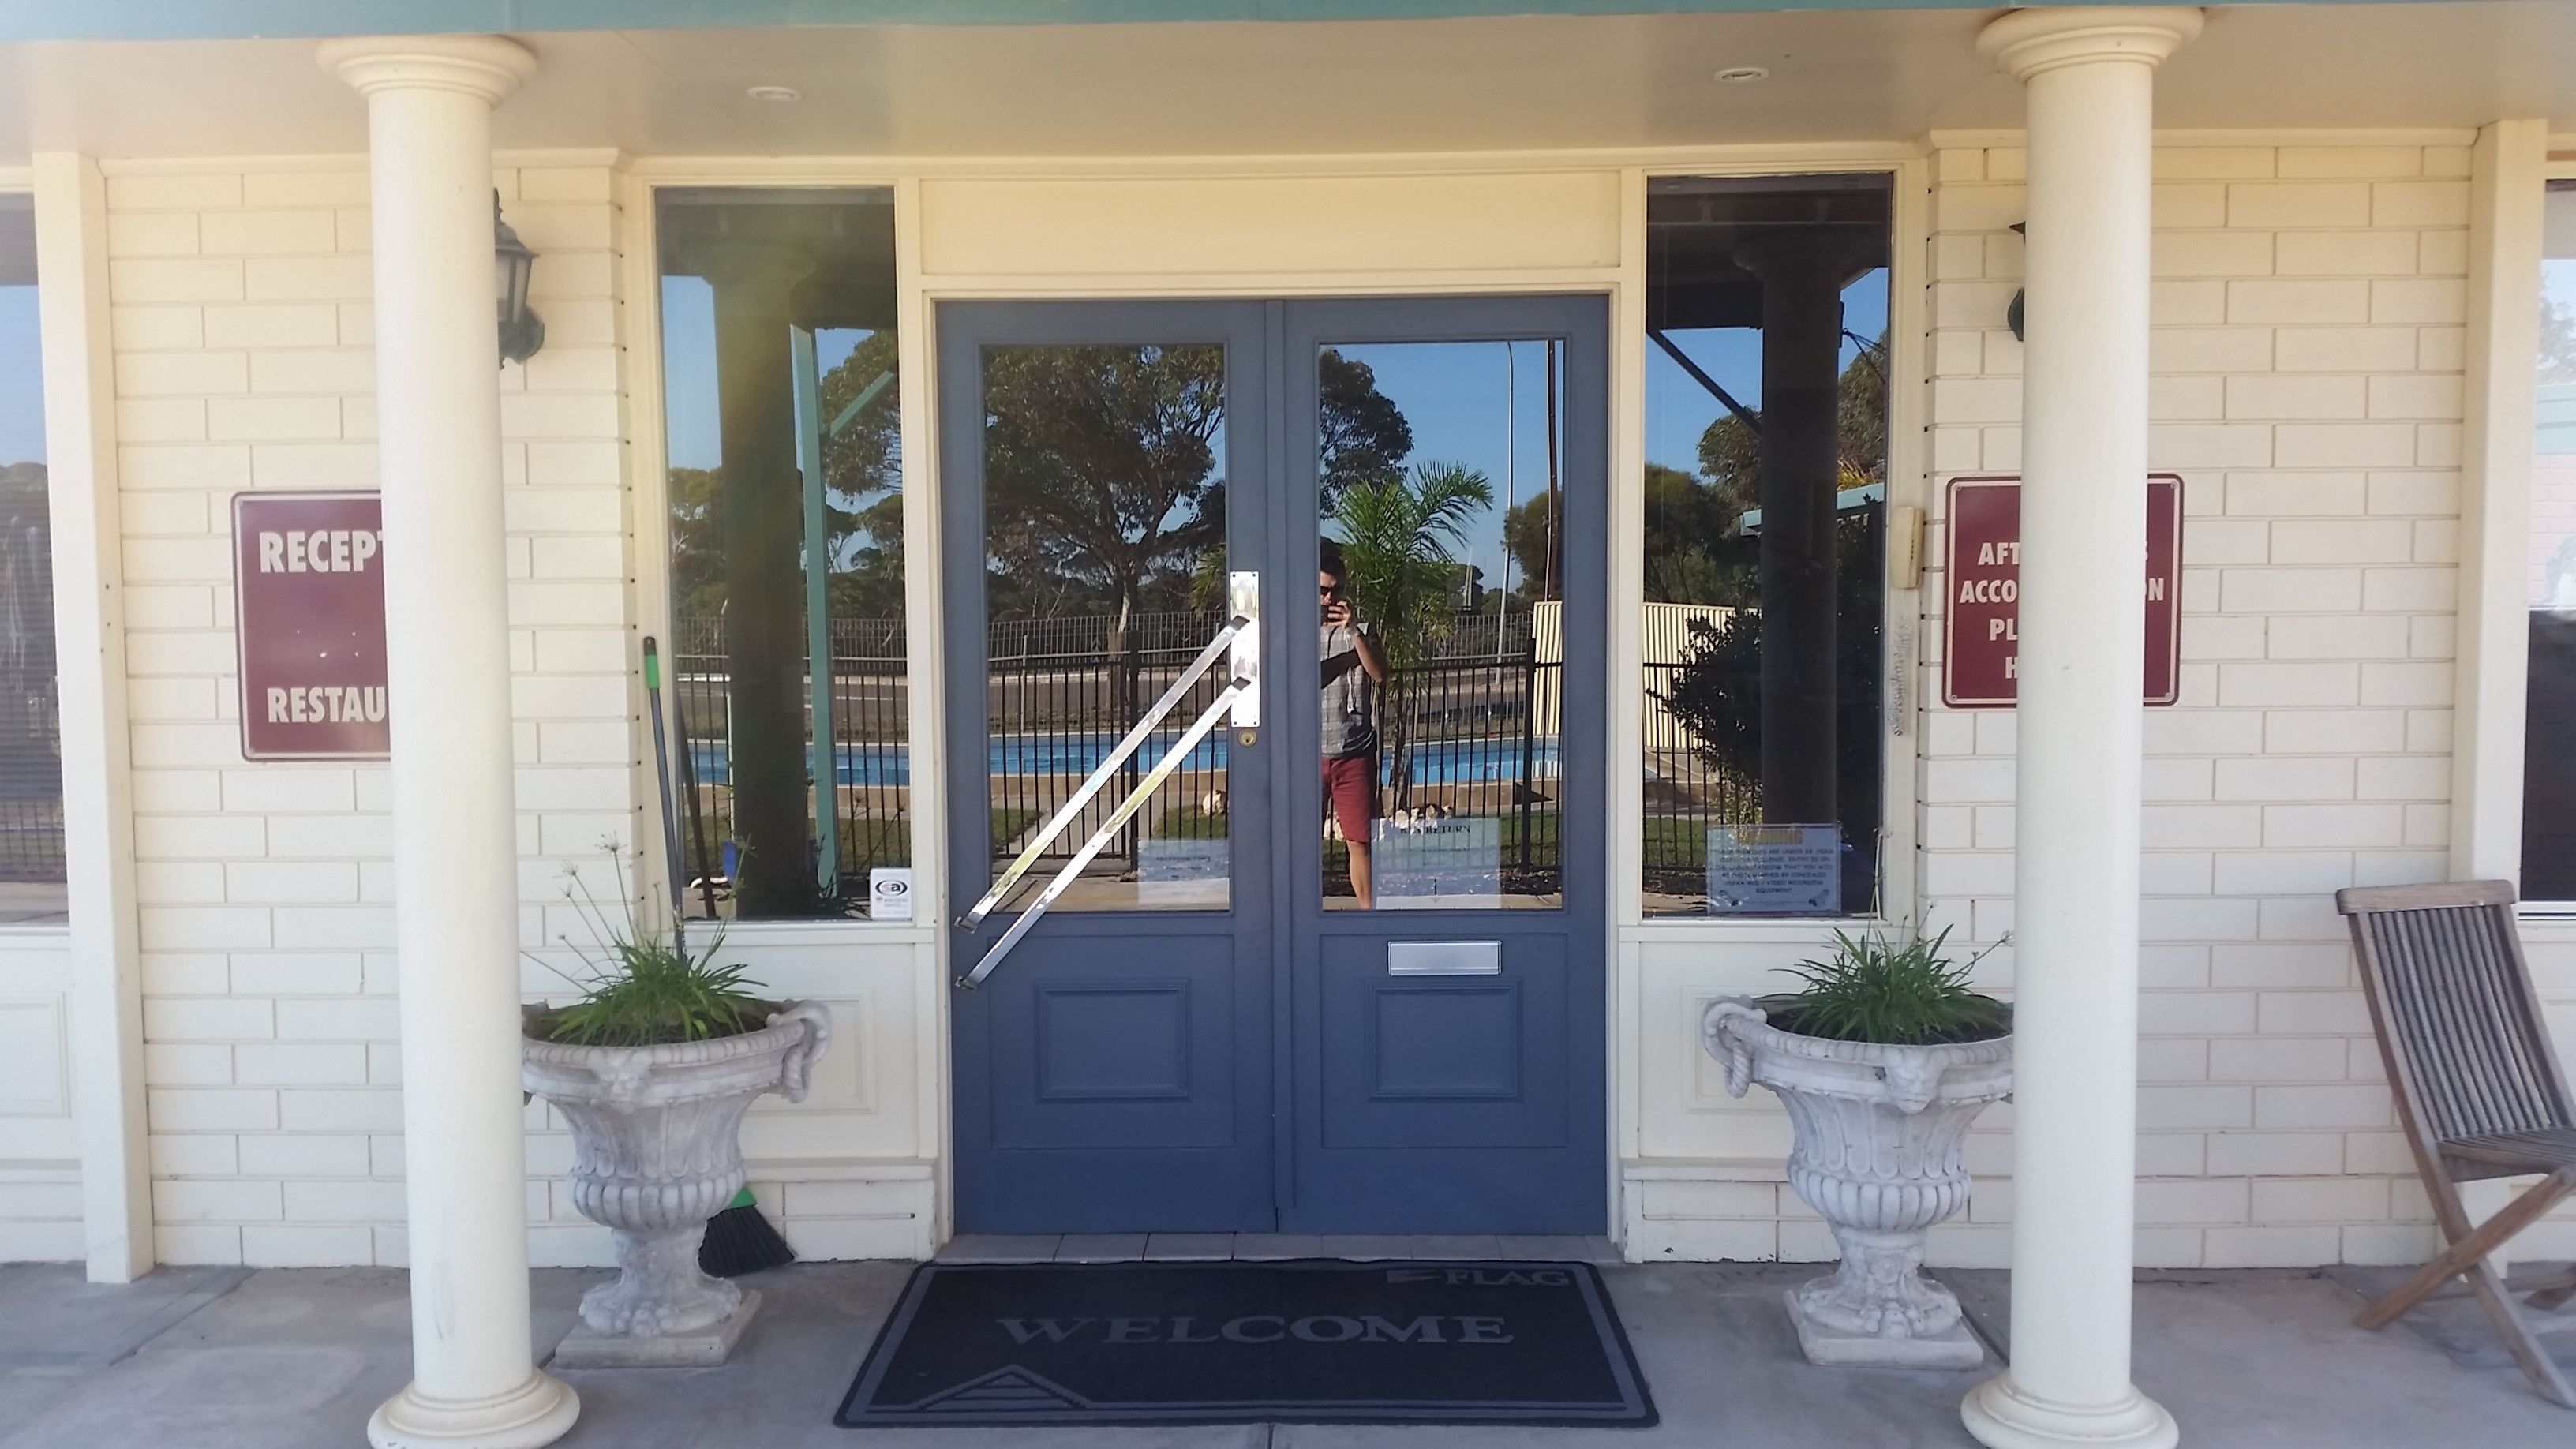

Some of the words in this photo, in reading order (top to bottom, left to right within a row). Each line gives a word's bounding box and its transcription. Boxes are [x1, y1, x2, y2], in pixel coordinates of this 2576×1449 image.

[1978, 542, 2020, 566] AFT
[1960, 579, 2017, 603] ACCO
[1990, 618, 2017, 642] PL
[267, 687, 386, 723] RESTAU
[1445, 1269, 1570, 1286] FLAG
[995, 1314, 1515, 1345] WELCOME
